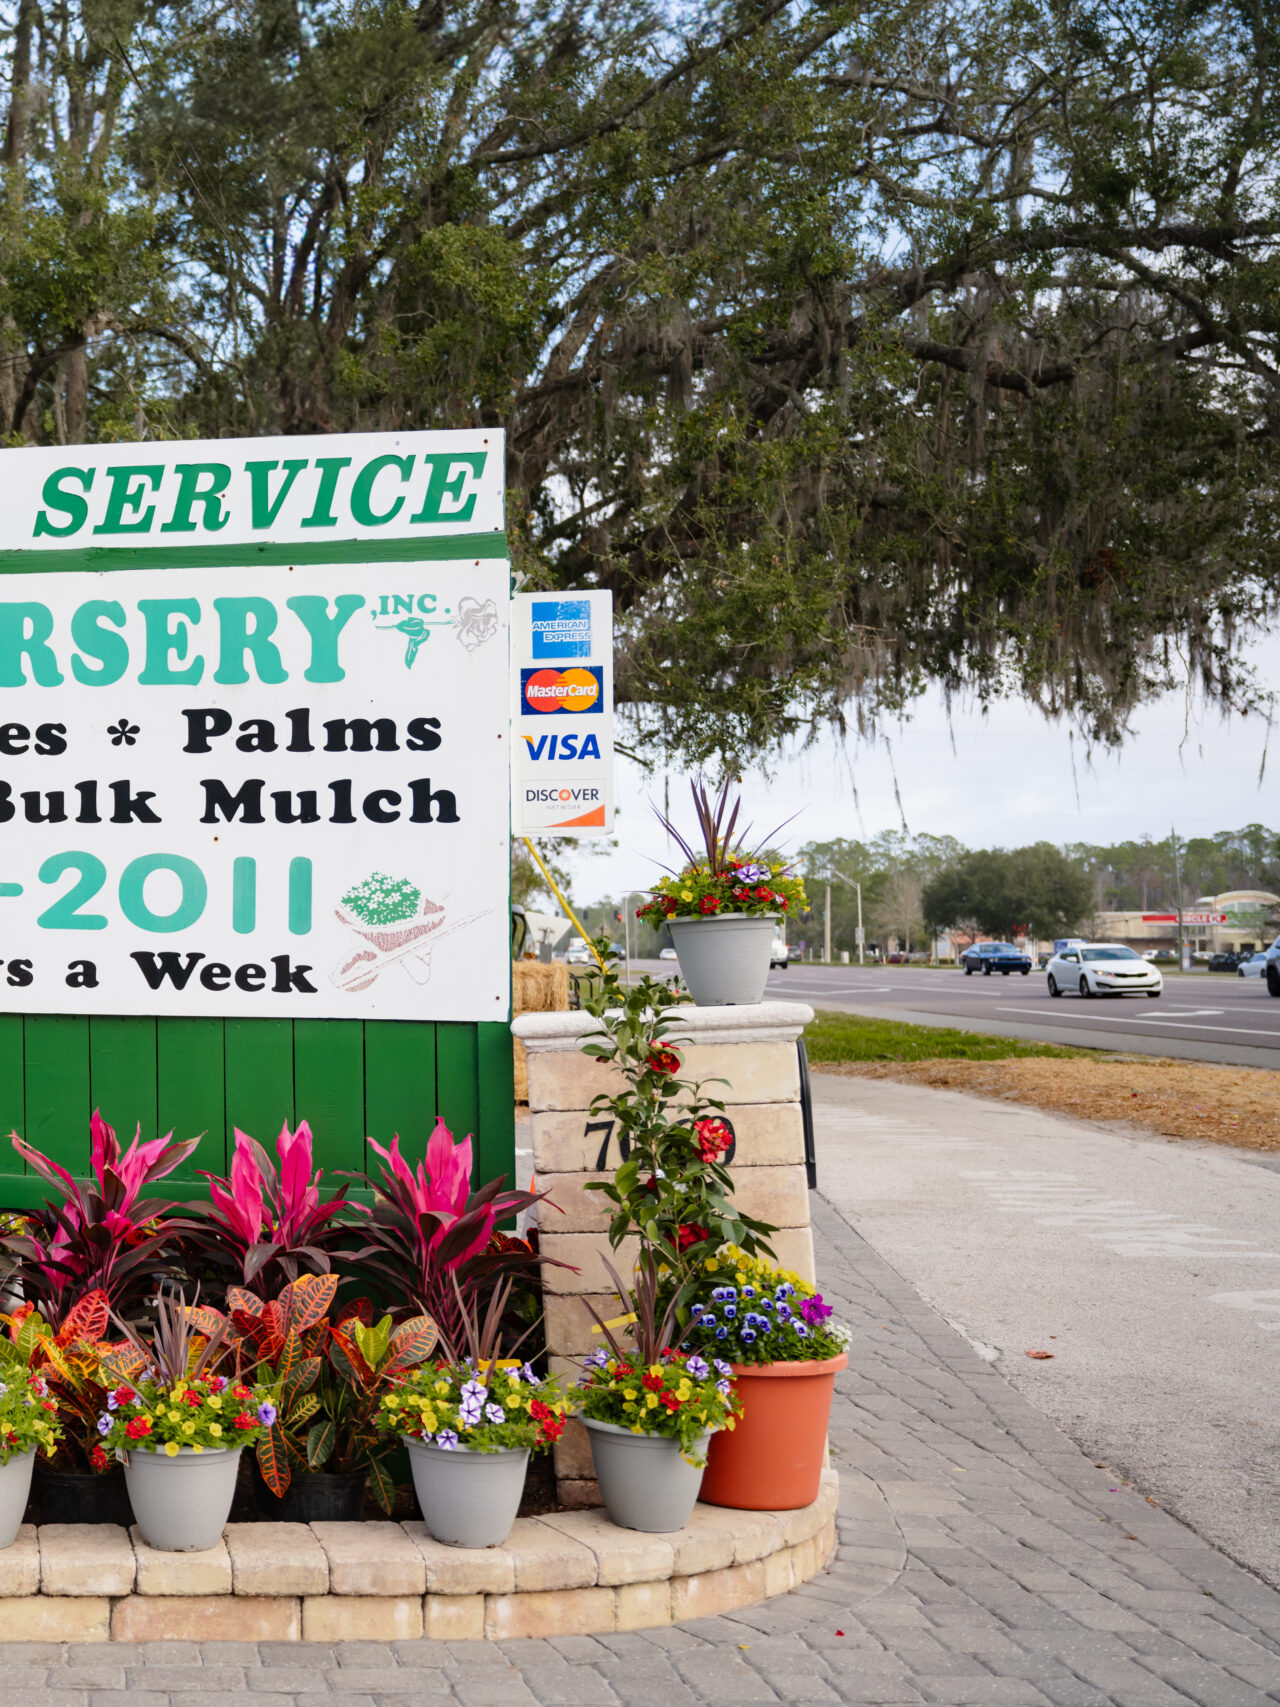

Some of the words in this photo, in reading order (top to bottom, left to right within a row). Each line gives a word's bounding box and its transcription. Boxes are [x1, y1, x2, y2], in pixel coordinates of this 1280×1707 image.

[32, 451, 488, 538] SERVICE
[533, 621, 587, 630] AMERICAN
[545, 632, 590, 640] EXPRESS
[526, 683, 597, 698] MasterCard
[181, 707, 442, 753] Palms
[521, 734, 601, 760] VISA
[200, 778, 460, 824] Mulch
[526, 788, 600, 801] DISCOVER
[65, 960, 99, 988] a
[130, 951, 318, 994] Week
